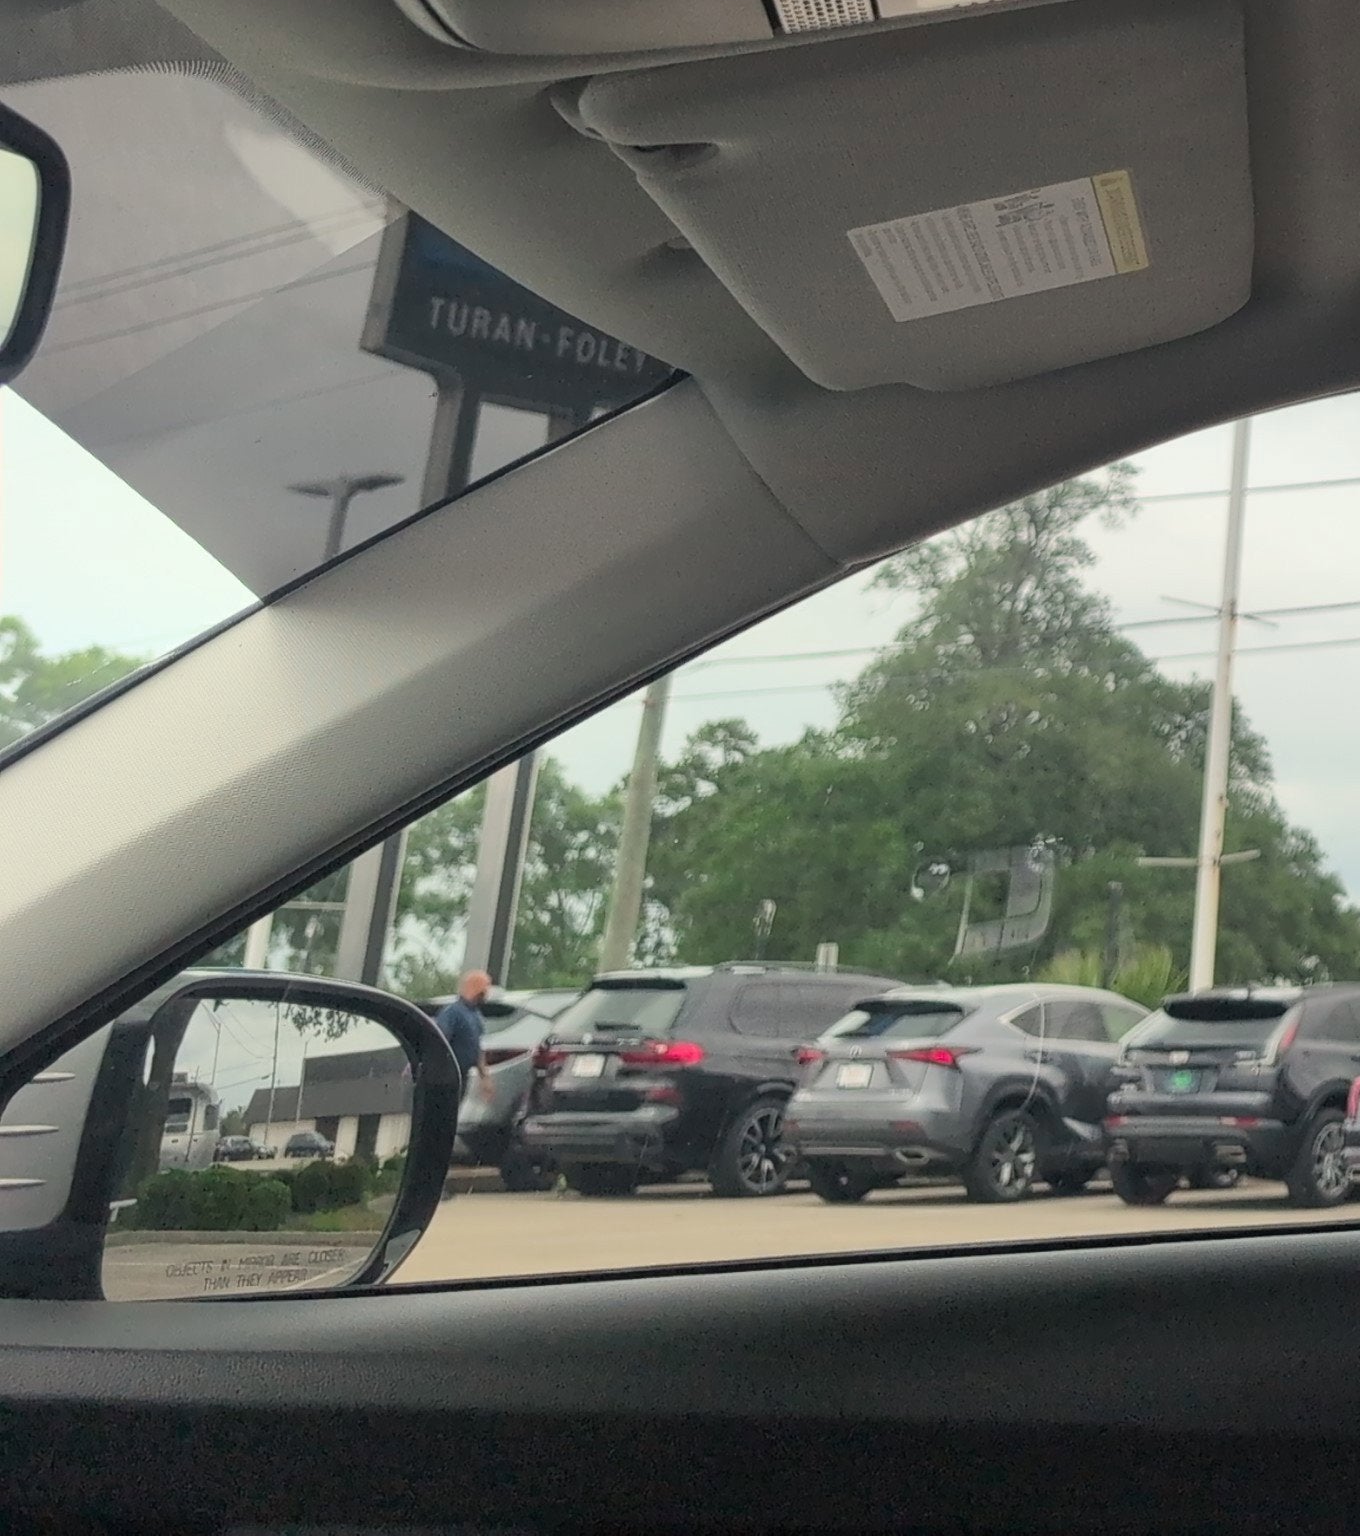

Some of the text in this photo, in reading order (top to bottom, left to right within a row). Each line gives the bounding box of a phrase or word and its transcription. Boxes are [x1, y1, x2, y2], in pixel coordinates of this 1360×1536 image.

[165, 1248, 346, 1278] OBJECTS IN MIRROR ARE CLOSER
[203, 1269, 308, 1291] THAN THEY APPEAR
